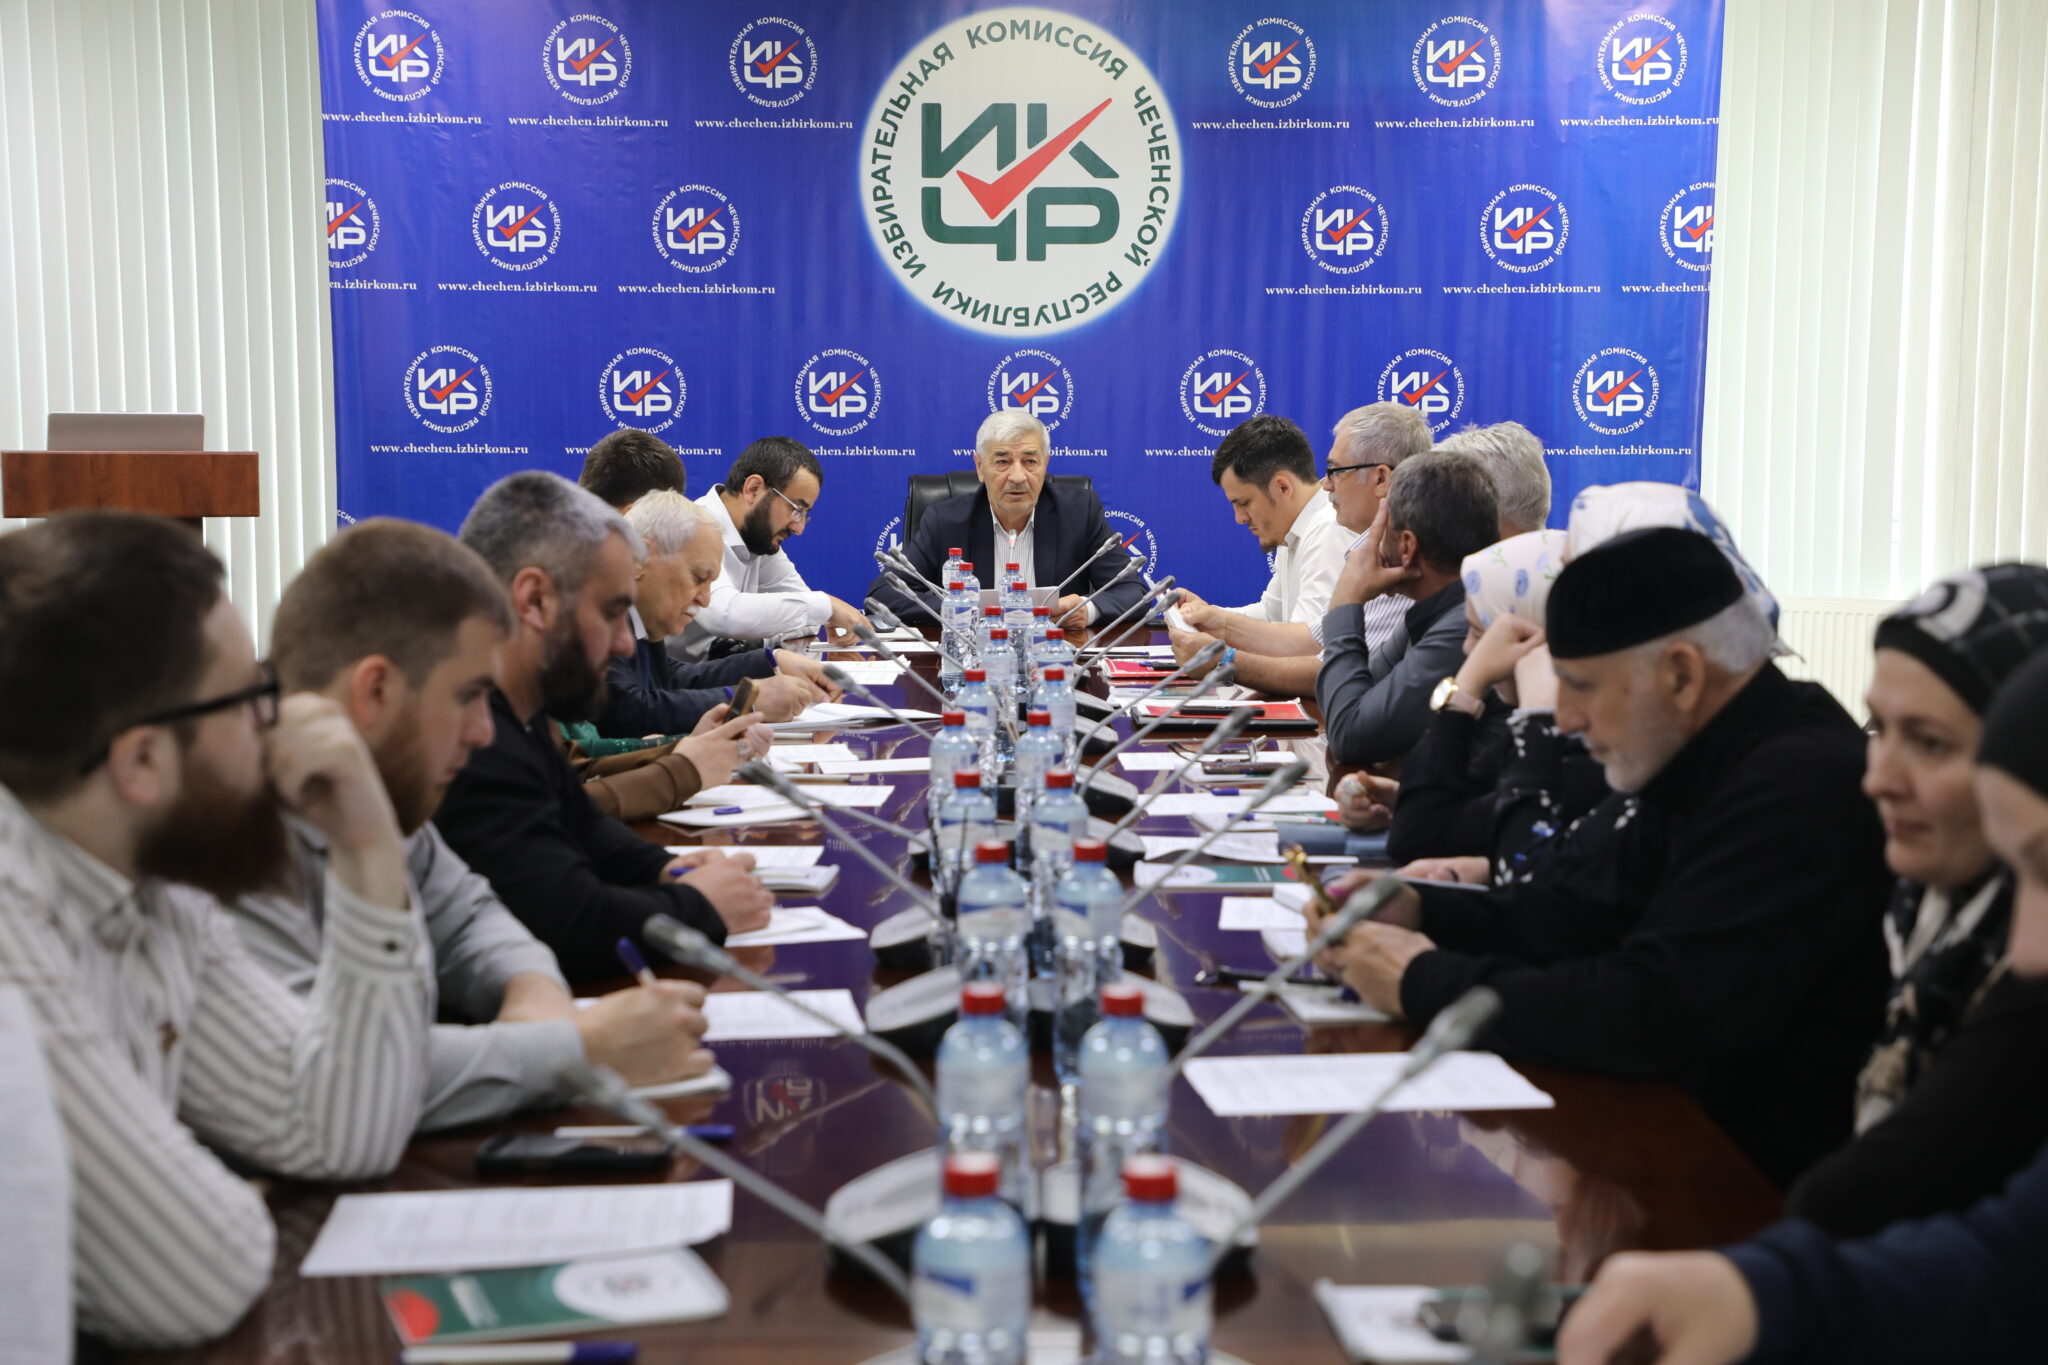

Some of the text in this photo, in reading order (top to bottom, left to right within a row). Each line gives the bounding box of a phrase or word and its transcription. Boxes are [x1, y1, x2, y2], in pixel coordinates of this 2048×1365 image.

[353, 9, 445, 102] ИЗБИРАТЕЛЬНАЯ КОМИССИЯ ЧЕЧЕНСКОЙ РЕСПУБЛИКИ
[542, 13, 632, 106] ИЗБИРАТЕЛЬНАЯ КОМИССИЯ ЧЕЧЕНСКОЙ РЕСПУБЛИКИ
[729, 16, 818, 108] ИЗБИРАТЕЛЬНАЯ КОМИССИЯ ЧЕЧЕНСКОЙ РЕСПУБЛИКИ
[1228, 17, 1317, 108] ИЗБИРАТЕЛЬНАЯ КОМИССИЯ ЧЕЧЕНСКОЙ РЕСПУБЛИКИ
[1412, 15, 1501, 107] ИЗБИРАТЕЛЬНАЯ КОМИССИЯ ЧЕЧЕНСКОЙ РЕСПУБЛИКИ
[1597, 13, 1688, 105] ИЗБИРАТЕЛЬНАЯ КОМИССИЯ ЧЕЧЕНСКОЙ РЕСПУБЛИКИ
[322, 111, 482, 124] www.chechen.izbirkom.ru
[508, 114, 669, 127] www.chechen.izbirkom.ru
[694, 117, 853, 129] www.chechen.izbirkom.ru
[1192, 118, 1350, 129] www.chechen.izbirkom.ru
[1375, 116, 1535, 128] www.chechen.izbirkom.ru
[1560, 115, 1719, 126] www.chechen.izbirkom.ru
[871, 20, 1171, 327] ИЗБИРАТЕЛЬНАЯ КОМИССИЯ ЧЕЧЕНСКОЙ РЕСПУБЛИКИ
[326, 178, 367, 198] ОМИССИЯ
[366, 198, 380, 252] ЧЕЧЕНСКОЙ
[472, 181, 561, 271] ИЗБИРАТЕЛЬНАЯ КОМИССИЯ ЧЕЧЕНСКОЙ РЕСПУБЛИКИ
[652, 184, 740, 273] ИЗБИРАТЕЛЬНАЯ КОМИССИЯ ЧЕЧЕНСКОЙ РЕСПУБЛИКИ
[1301, 185, 1389, 274] ИЗБИРАТЕЛЬНАЯ КОМИССИЯ ЧЕЧЕНСКОЙ РЕСПУБЛИКИ
[1480, 183, 1569, 273] ИЗБИРАТЕЛЬНАЯ КОМИССИЯ ЧЕЧЕНСКОЙ РЕСПУБЛИКИ
[1659, 188, 1687, 258] ИЗБИРАТЕЛЬНАЯ
[437, 280, 598, 293] www.chechen.izbirkom.ru
[617, 282, 776, 294] www.chechen.izbirkom.ru
[1265, 283, 1422, 295] www.chechen.izbirkom.ru
[1443, 282, 1601, 294] www.chechen.izbirkom.ru
[403, 345, 493, 433] ИЗБИРАТЕЛЬНАЯ КОМИССИЯ ЧЕЧЕНСКОЙ РЕСПУБЛИКИ
[599, 353, 624, 421] ИЗБИРАТЕЛЬНАЯ
[625, 347, 674, 366] КОМИССИЯ
[672, 366, 687, 418] ЧЕЧЕНСКОЙ
[794, 348, 882, 436] ИЗБИРАТЕЛЬНАЯ КОМИССИЯ ЧЕЧЕНСКОЙ РЕСПУБЛИКИ
[1014, 349, 1062, 367] КОМИССИЯ
[1059, 367, 1074, 419] ЧЕЧЕНСКОЙ
[1179, 355, 1205, 423] ИЗБИРАТЕЛЬНАЯ
[1207, 349, 1255, 367] КОМИССИЯ
[1405, 348, 1453, 366] КОМИССИЯ
[1449, 366, 1465, 418] ЧЕЧЕНСКОЙ
[1572, 347, 1659, 435] ИЗБИРАТЕЛЬНАЯ КОМИССИЯ ЧЕЧЕНСКОЙ РЕСПУБЛИКИ
[370, 442, 529, 454] www.chechen.izbirkom.ru
